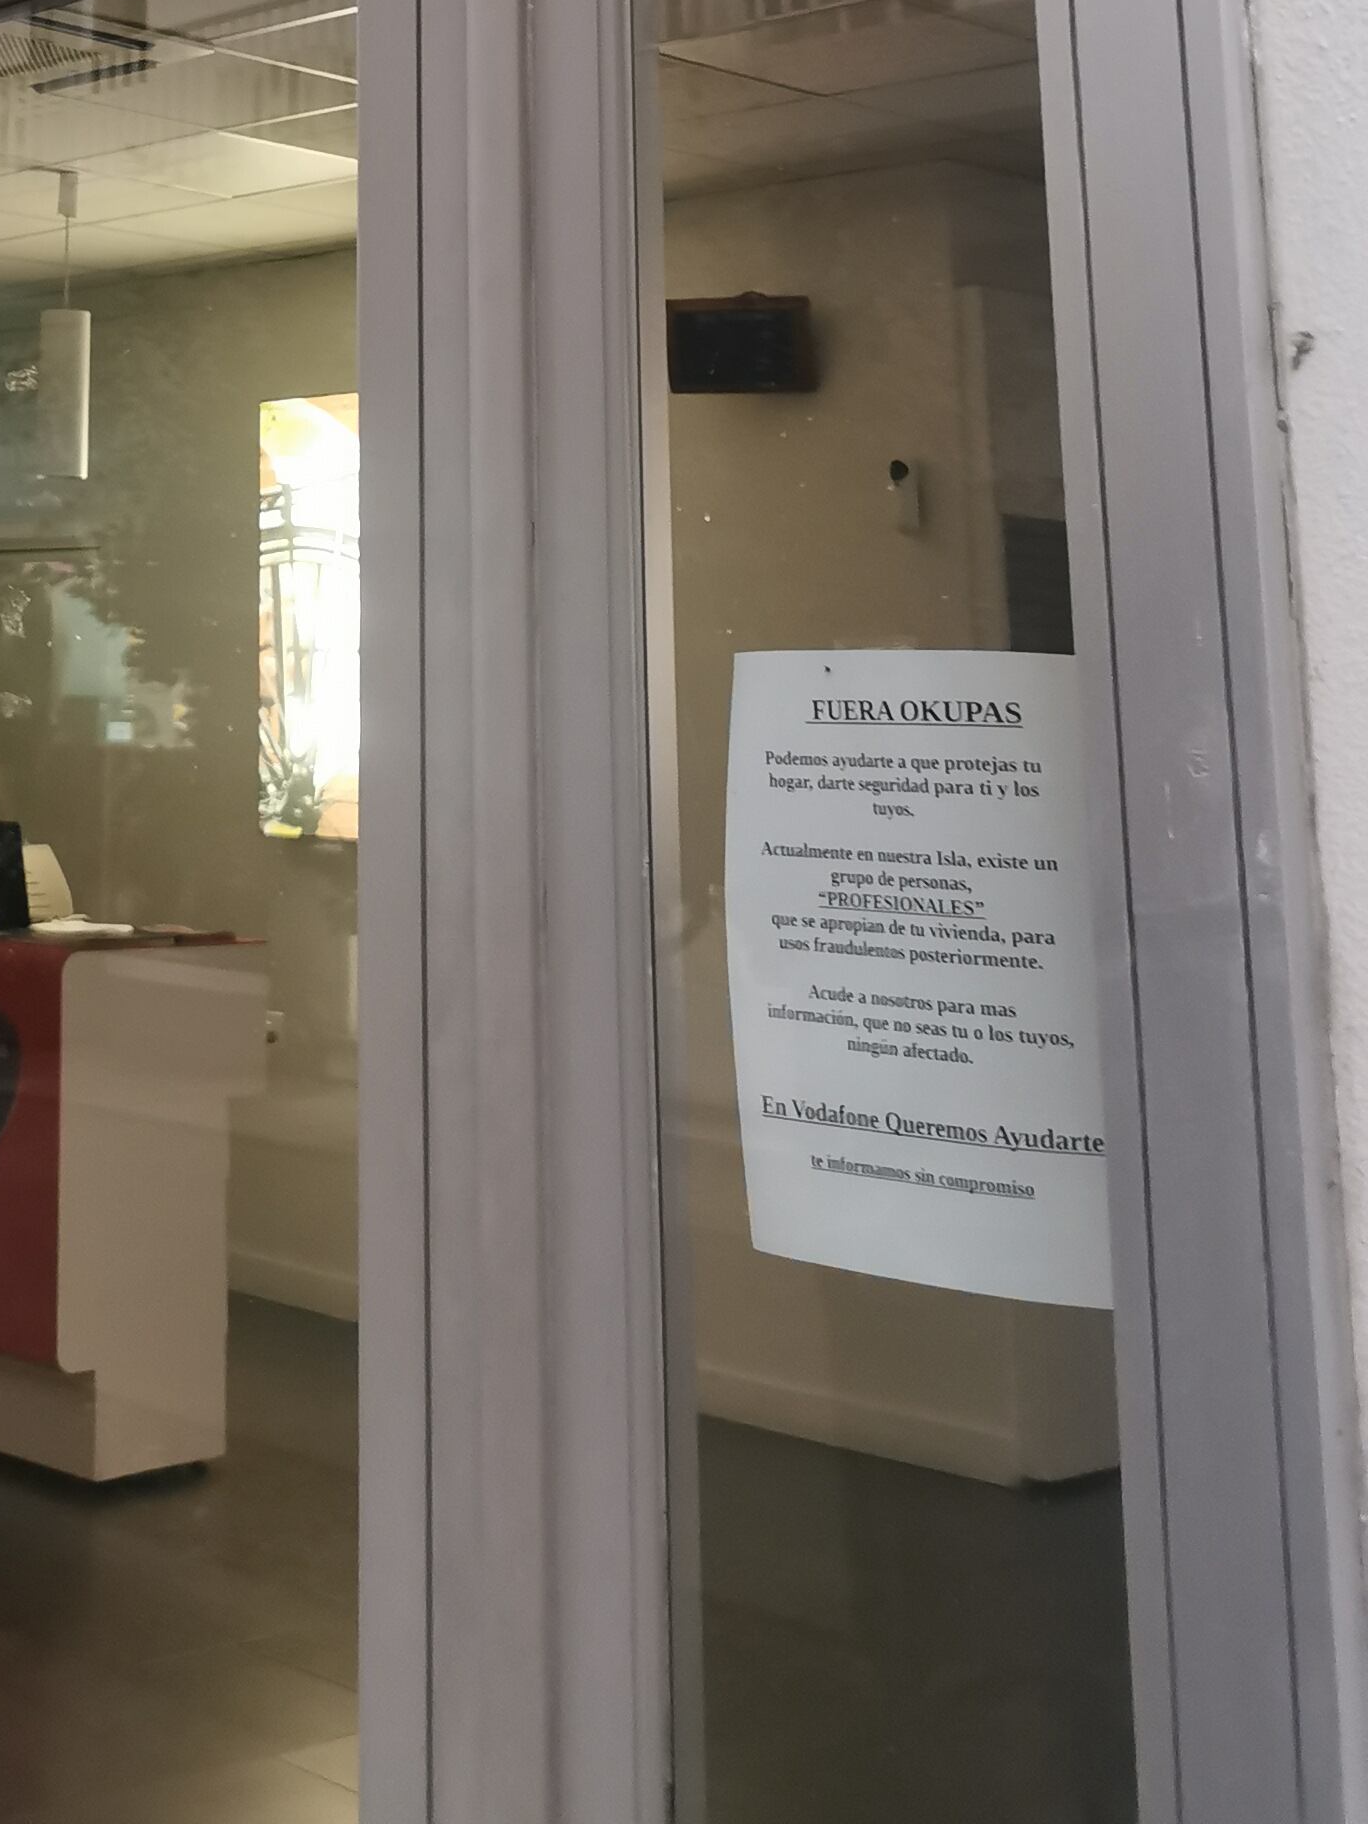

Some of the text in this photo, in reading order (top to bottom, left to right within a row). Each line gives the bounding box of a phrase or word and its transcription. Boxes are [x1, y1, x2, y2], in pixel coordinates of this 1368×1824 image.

[811, 699, 1023, 724] FUERA OKUPAS
[765, 750, 1042, 775] Podemos ayudarte a que protejas tu
[769, 772, 1040, 800] hogar, darte seguridad para ti y los
[872, 803, 914, 820] tuyos.
[761, 841, 1059, 871] Actualmente en nuestra Isla, existe un
[831, 871, 973, 893] grupo de personas,
[771, 914, 1056, 947] que se apropian de tu vivienda, para
[779, 937, 1044, 970] usos fraudulentos posteriormente.
[808, 984, 1017, 1018] Acude a nosotros para mas
[863, 1017, 889, 1033] que
[893, 1020, 912, 1033] no
[915, 1022, 948, 1037] seas
[952, 1025, 969, 1039] tu
[973, 1030, 983, 1040] o
[988, 1025, 1014, 1043] los
[1019, 1030, 1075, 1049] tuyos,
[903, 1043, 974, 1065] afectado.
[761, 1095, 1105, 1153] En Vodafone Queremos Ayudarte
[810, 1155, 1035, 1196] te informamos sin compromiso
